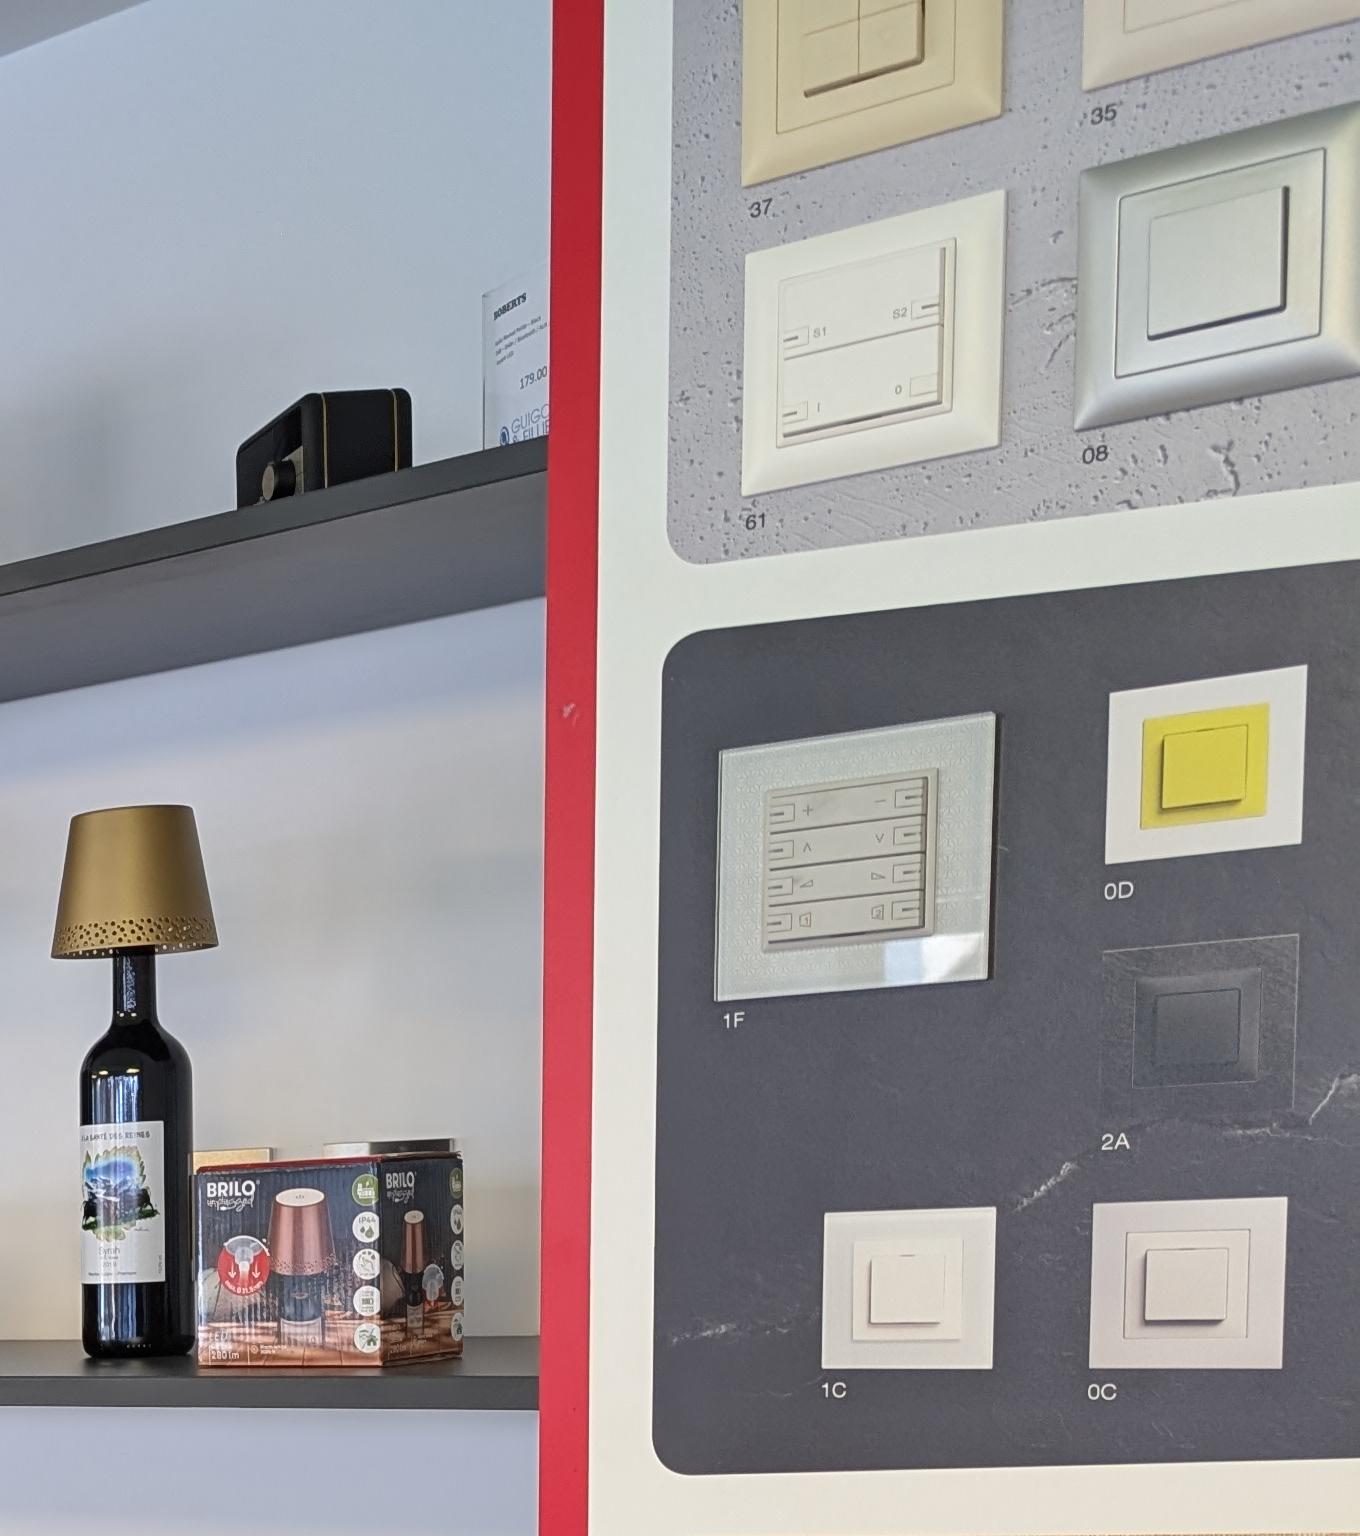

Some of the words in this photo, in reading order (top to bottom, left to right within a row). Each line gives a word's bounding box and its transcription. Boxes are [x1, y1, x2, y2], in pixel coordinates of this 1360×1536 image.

[1090, 103, 1119, 126] 35
[748, 197, 774, 220] 37
[493, 292, 527, 321] ROBERTS
[892, 306, 908, 320] S2
[813, 326, 827, 338] S1
[519, 365, 548, 390] 179.00
[1081, 444, 1110, 466] 08
[743, 512, 768, 533] 61
[722, 1012, 746, 1030] 1F
[1101, 1133, 1130, 1151] 2A
[206, 1179, 256, 1198] BRILO
[385, 1171, 415, 1189] BRILO
[821, 1382, 847, 1400] 1C
